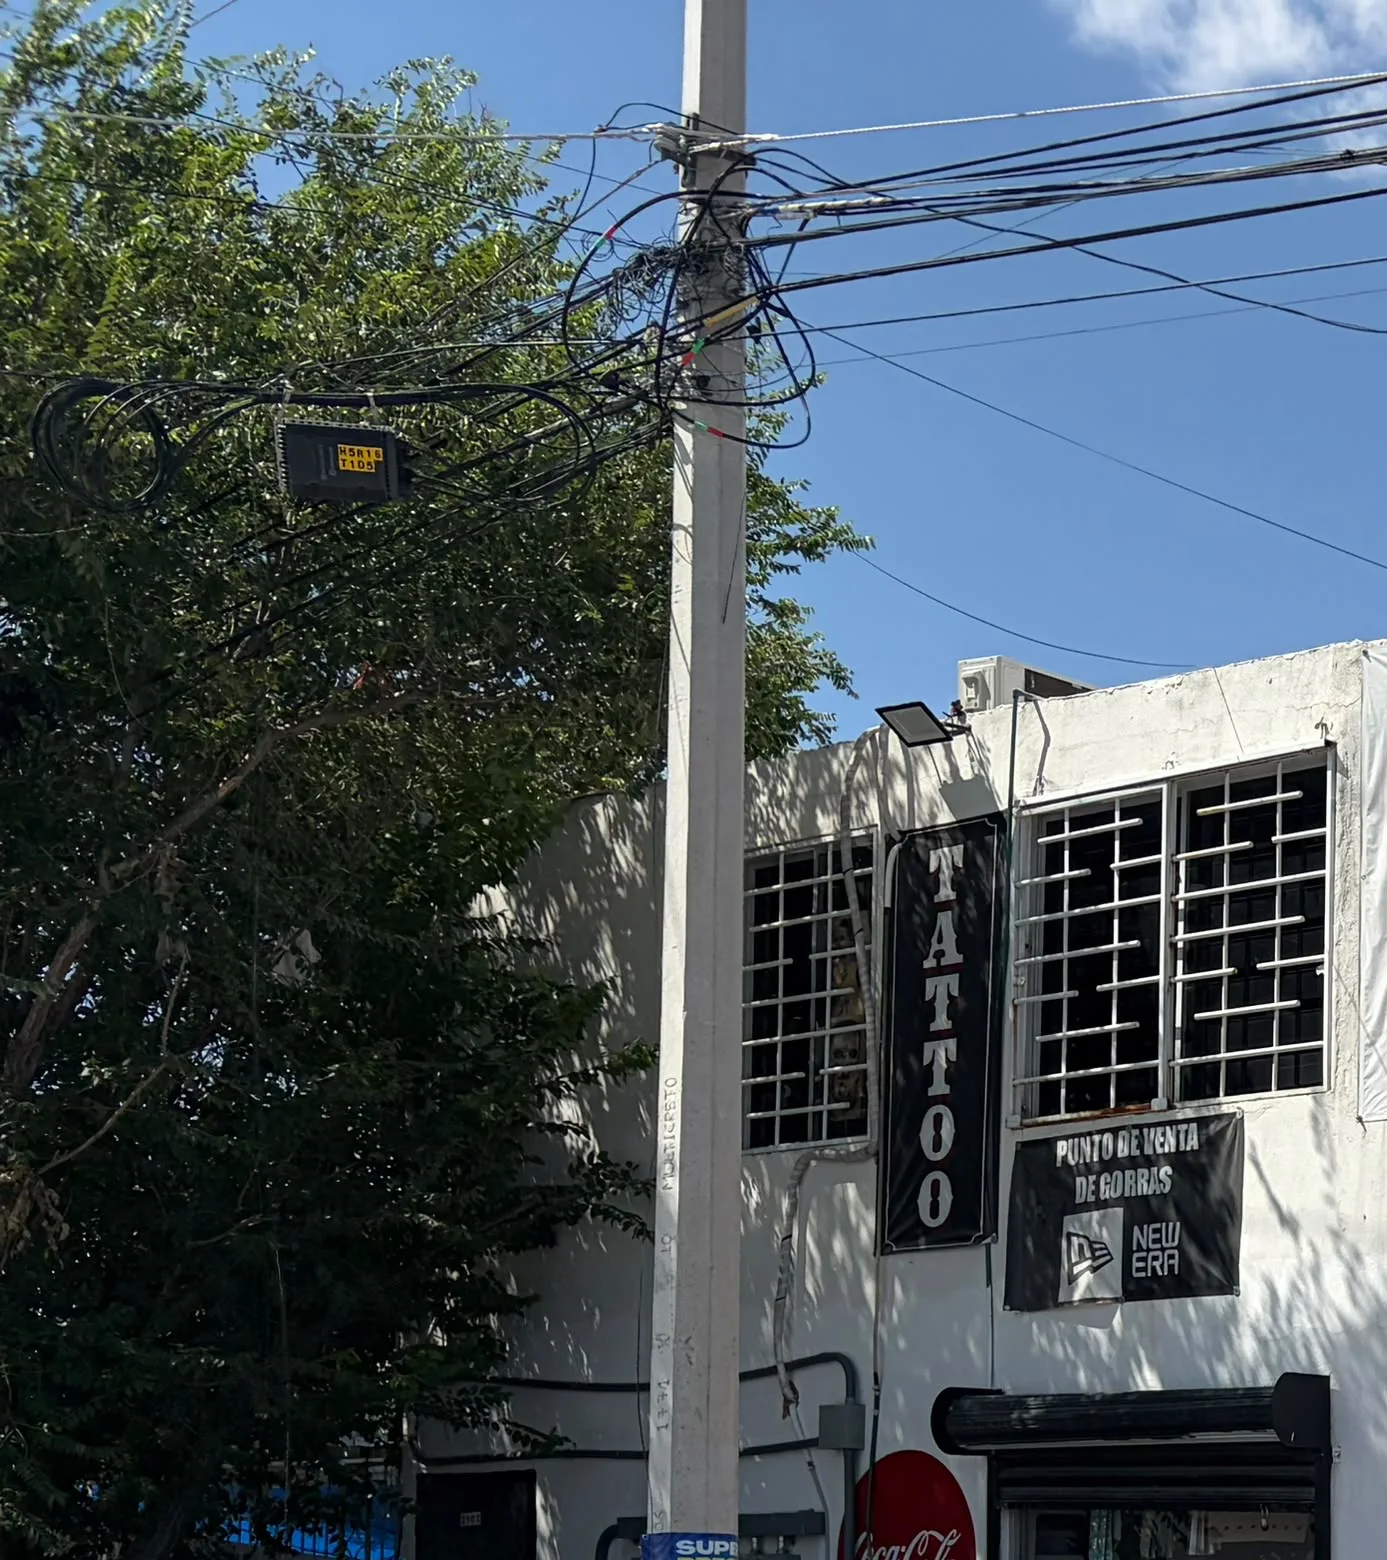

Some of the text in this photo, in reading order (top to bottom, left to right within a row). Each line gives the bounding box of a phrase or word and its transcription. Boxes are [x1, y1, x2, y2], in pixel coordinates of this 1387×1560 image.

[917, 843, 964, 1229] TATTOO
[1056, 1123, 1199, 1167] PUNTO DE VENTA
[1075, 1165, 1173, 1204] DE GORRAS
[1133, 1221, 1180, 1250] NEW
[1132, 1250, 1179, 1278] ERA
